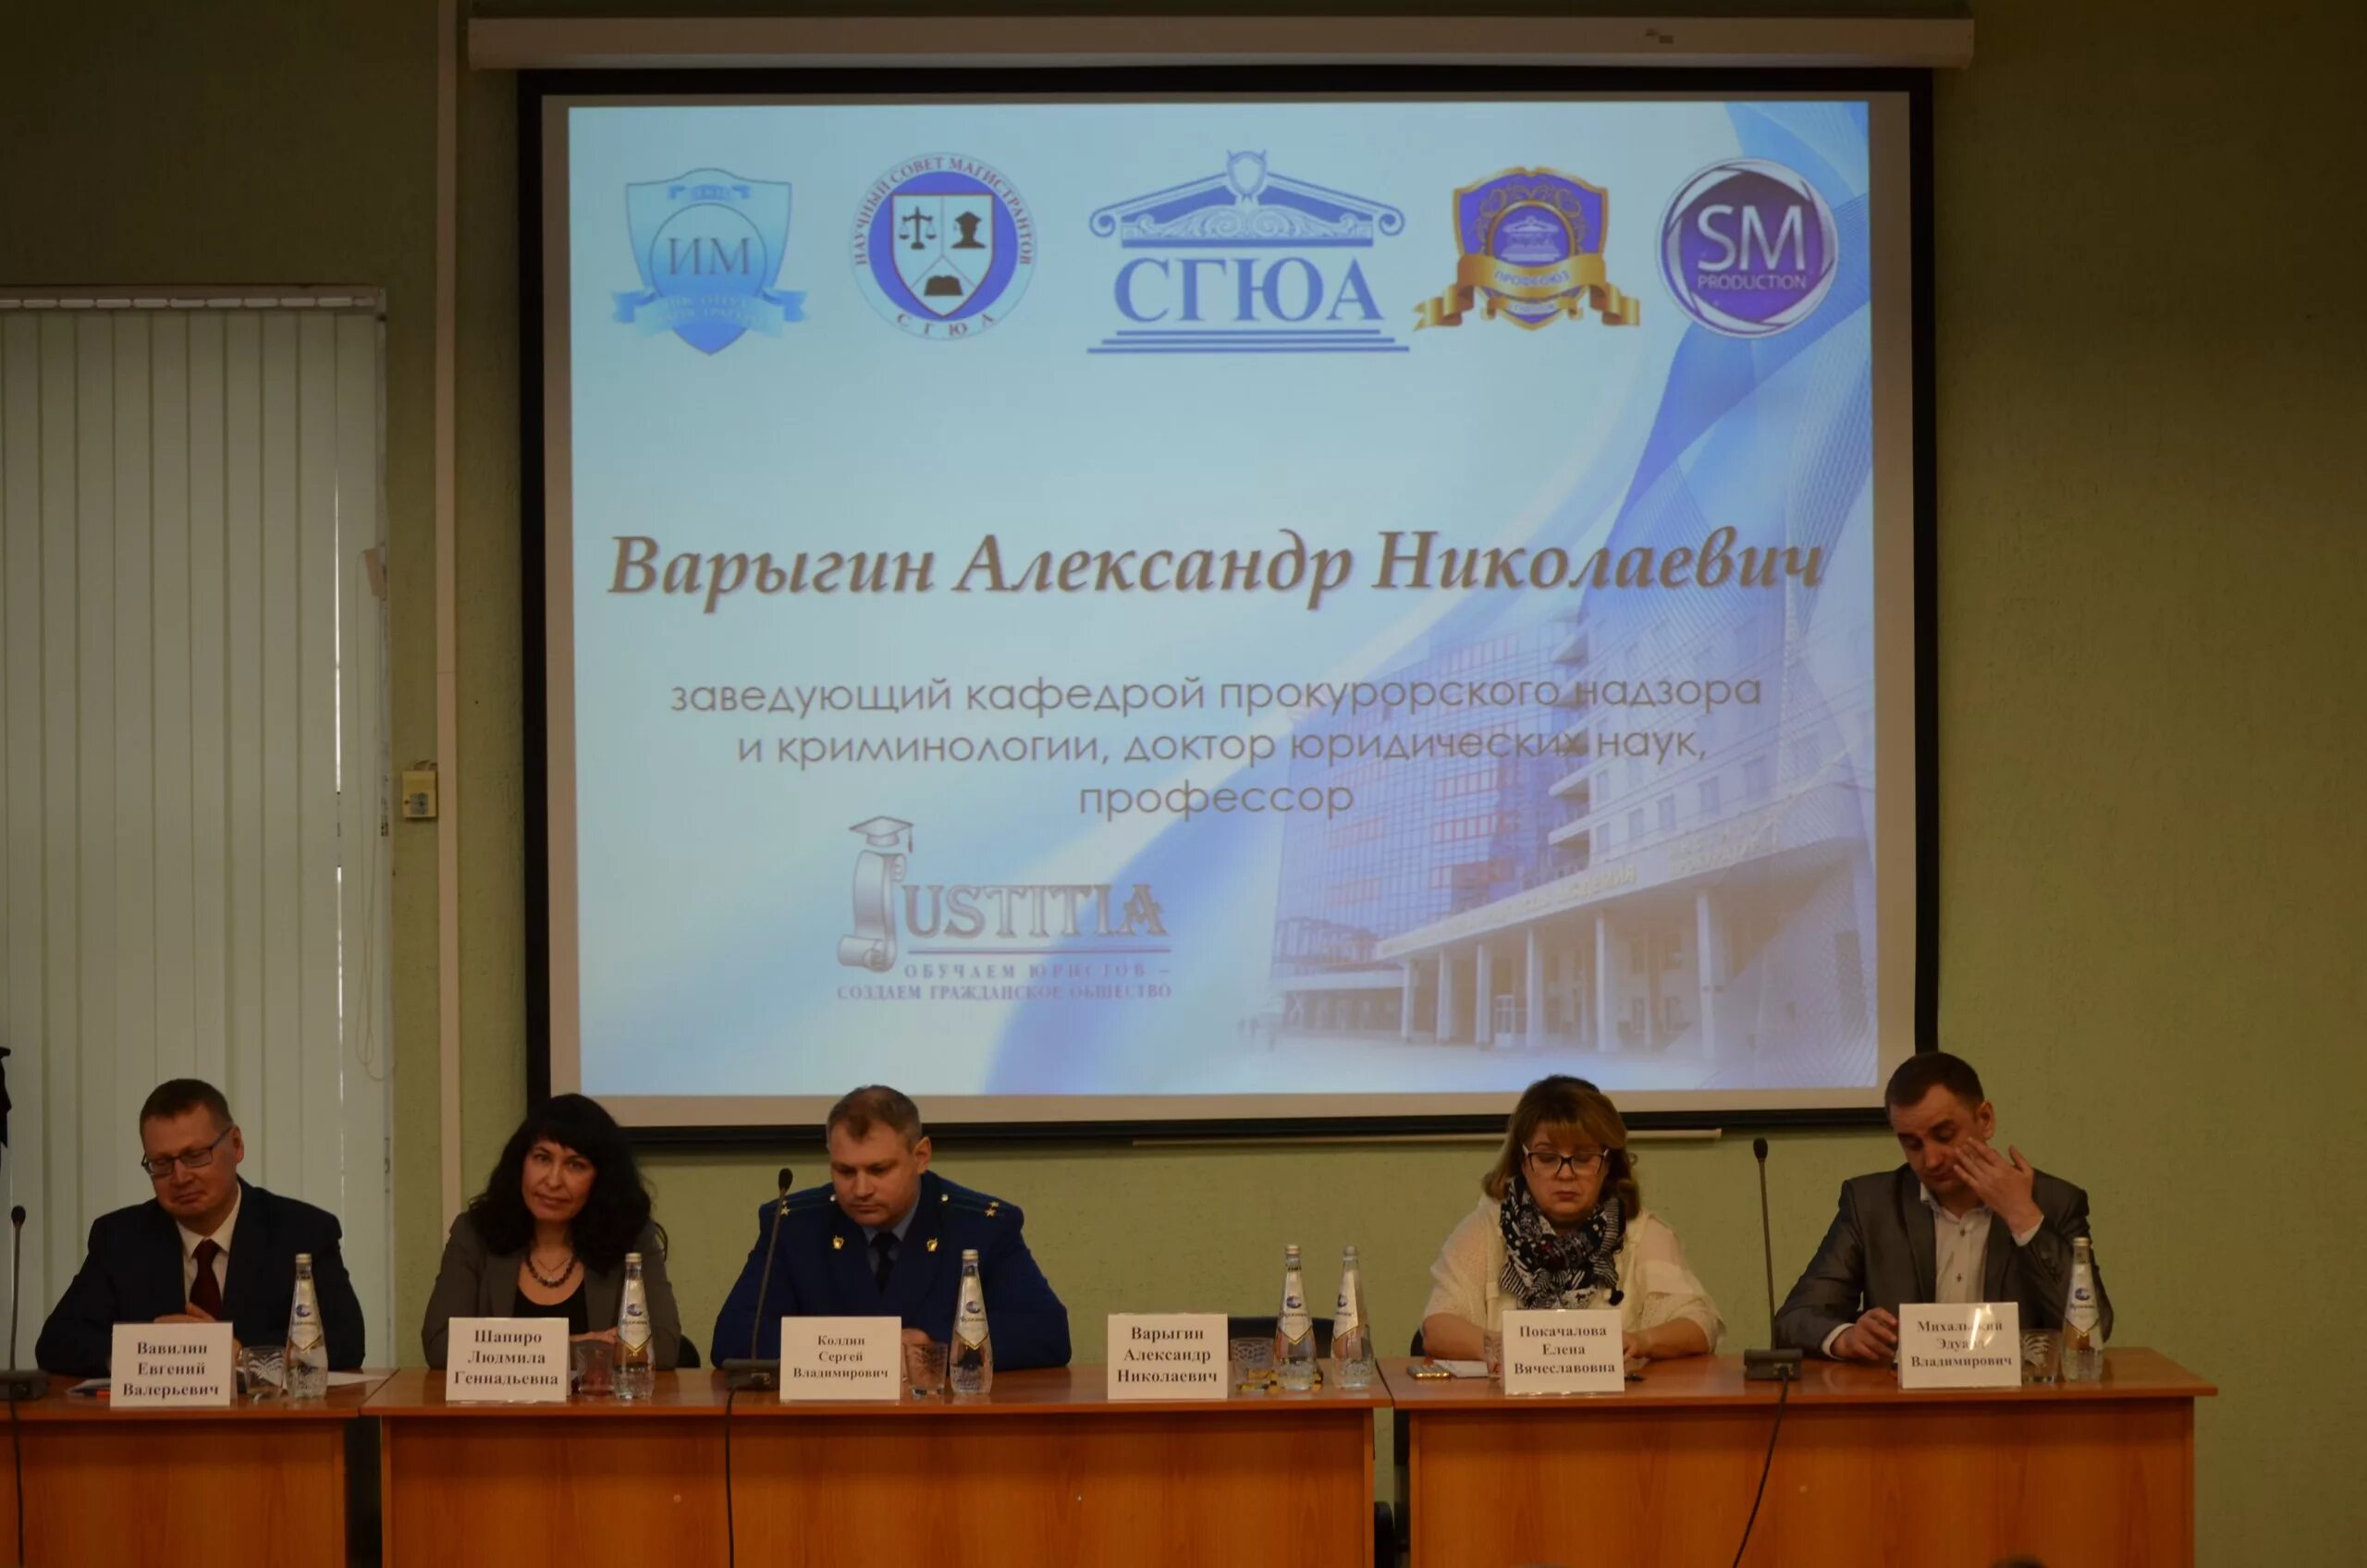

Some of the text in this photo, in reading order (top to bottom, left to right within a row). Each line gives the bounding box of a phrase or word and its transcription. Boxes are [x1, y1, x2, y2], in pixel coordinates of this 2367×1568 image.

[853, 156, 1033, 266] НАУЧНЫЙ СОВЕТ МАГИСТРАНТОВ
[1698, 204, 1805, 271] SM
[668, 237, 751, 276] ИМ
[1697, 273, 1808, 291] PRODUCTION
[1115, 256, 1386, 325] СГЮА
[607, 524, 1825, 615] Варыгин Александр Николаевич
[669, 676, 1762, 719] заведующий кафедрой прокурорского надзора
[738, 729, 1707, 771] и криминологии, доктор юридических наук,
[1079, 778, 1355, 822] профессор
[903, 962, 1015, 980] ОБУЧАЕМ
[1028, 962, 1146, 980] ЮРИСТОВ
[837, 983, 1172, 1001] СОЗДАЕМ ГРАЖДАНСКОЕ ОБЩЕСТВО
[1519, 1326, 1607, 1338] Покачалова
[1917, 1319, 2004, 1333] Михалький
[474, 1329, 543, 1346] Шапиро
[1131, 1327, 1205, 1342] Варыгин
[137, 1341, 208, 1355] Вавилин
[1123, 1348, 1211, 1364] Александр
[1542, 1343, 1586, 1356] Елена
[468, 1350, 546, 1366] Людмила
[818, 1351, 864, 1364] Сергей
[1911, 1355, 2013, 1369] Владимирович
[137, 1361, 206, 1377] Евгений
[793, 1367, 889, 1380] Владимирович
[1117, 1368, 1218, 1383] Николаевич
[1514, 1362, 1616, 1376] Вячеславовна
[454, 1371, 559, 1387] Геннадьевна
[123, 1383, 219, 1399] Валерьевич
